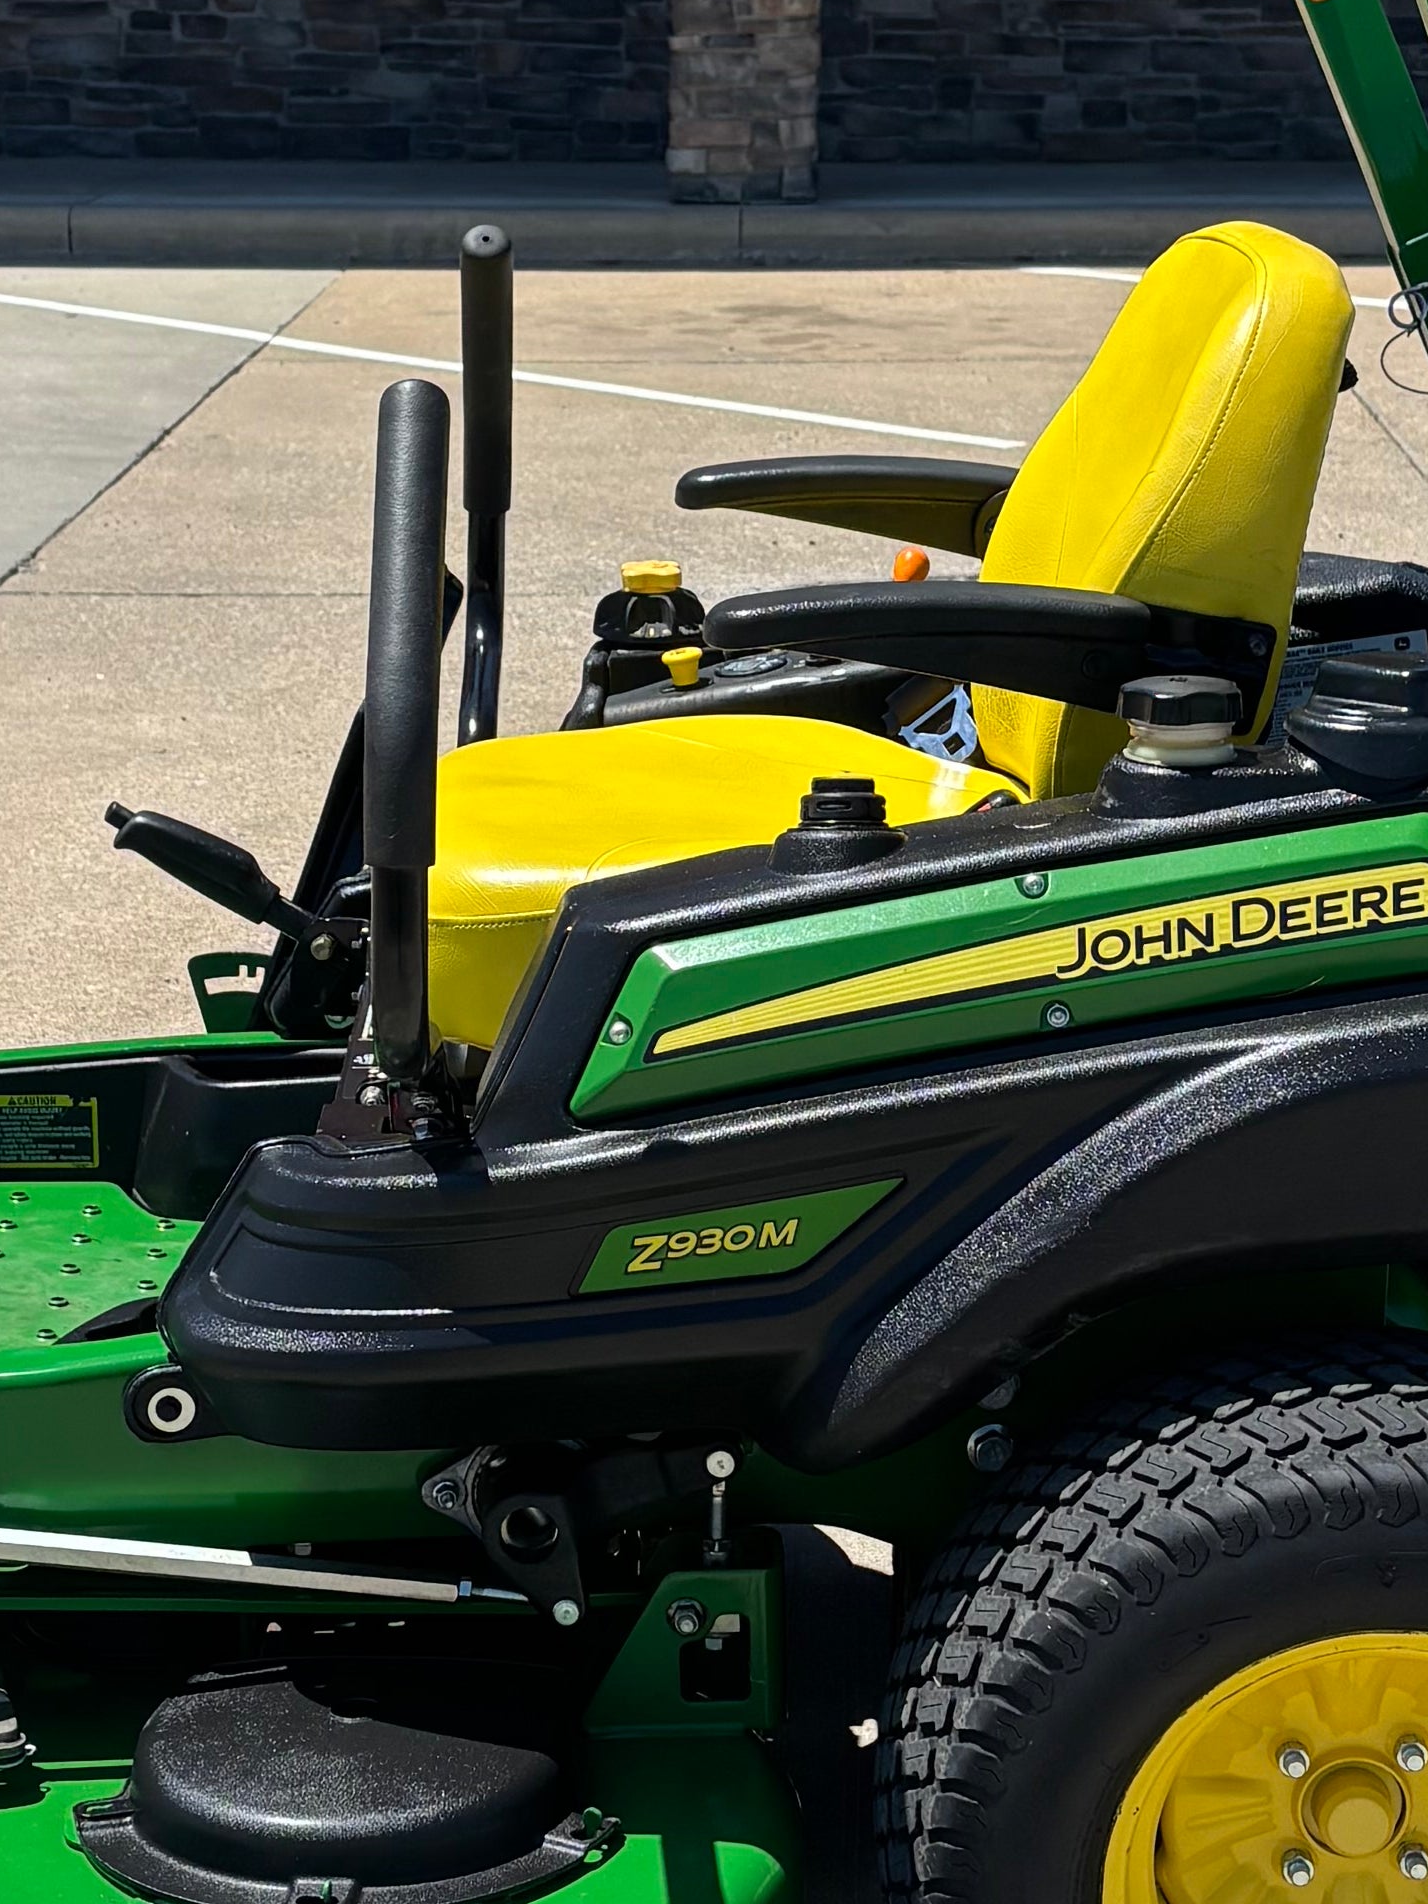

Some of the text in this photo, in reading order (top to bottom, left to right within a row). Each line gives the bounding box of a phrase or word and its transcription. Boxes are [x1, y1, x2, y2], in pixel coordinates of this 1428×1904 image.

[1056, 877, 1426, 976] JOHN DEERE
[16, 1095, 57, 1106] CAUTION
[625, 1217, 800, 1274] Z930M
